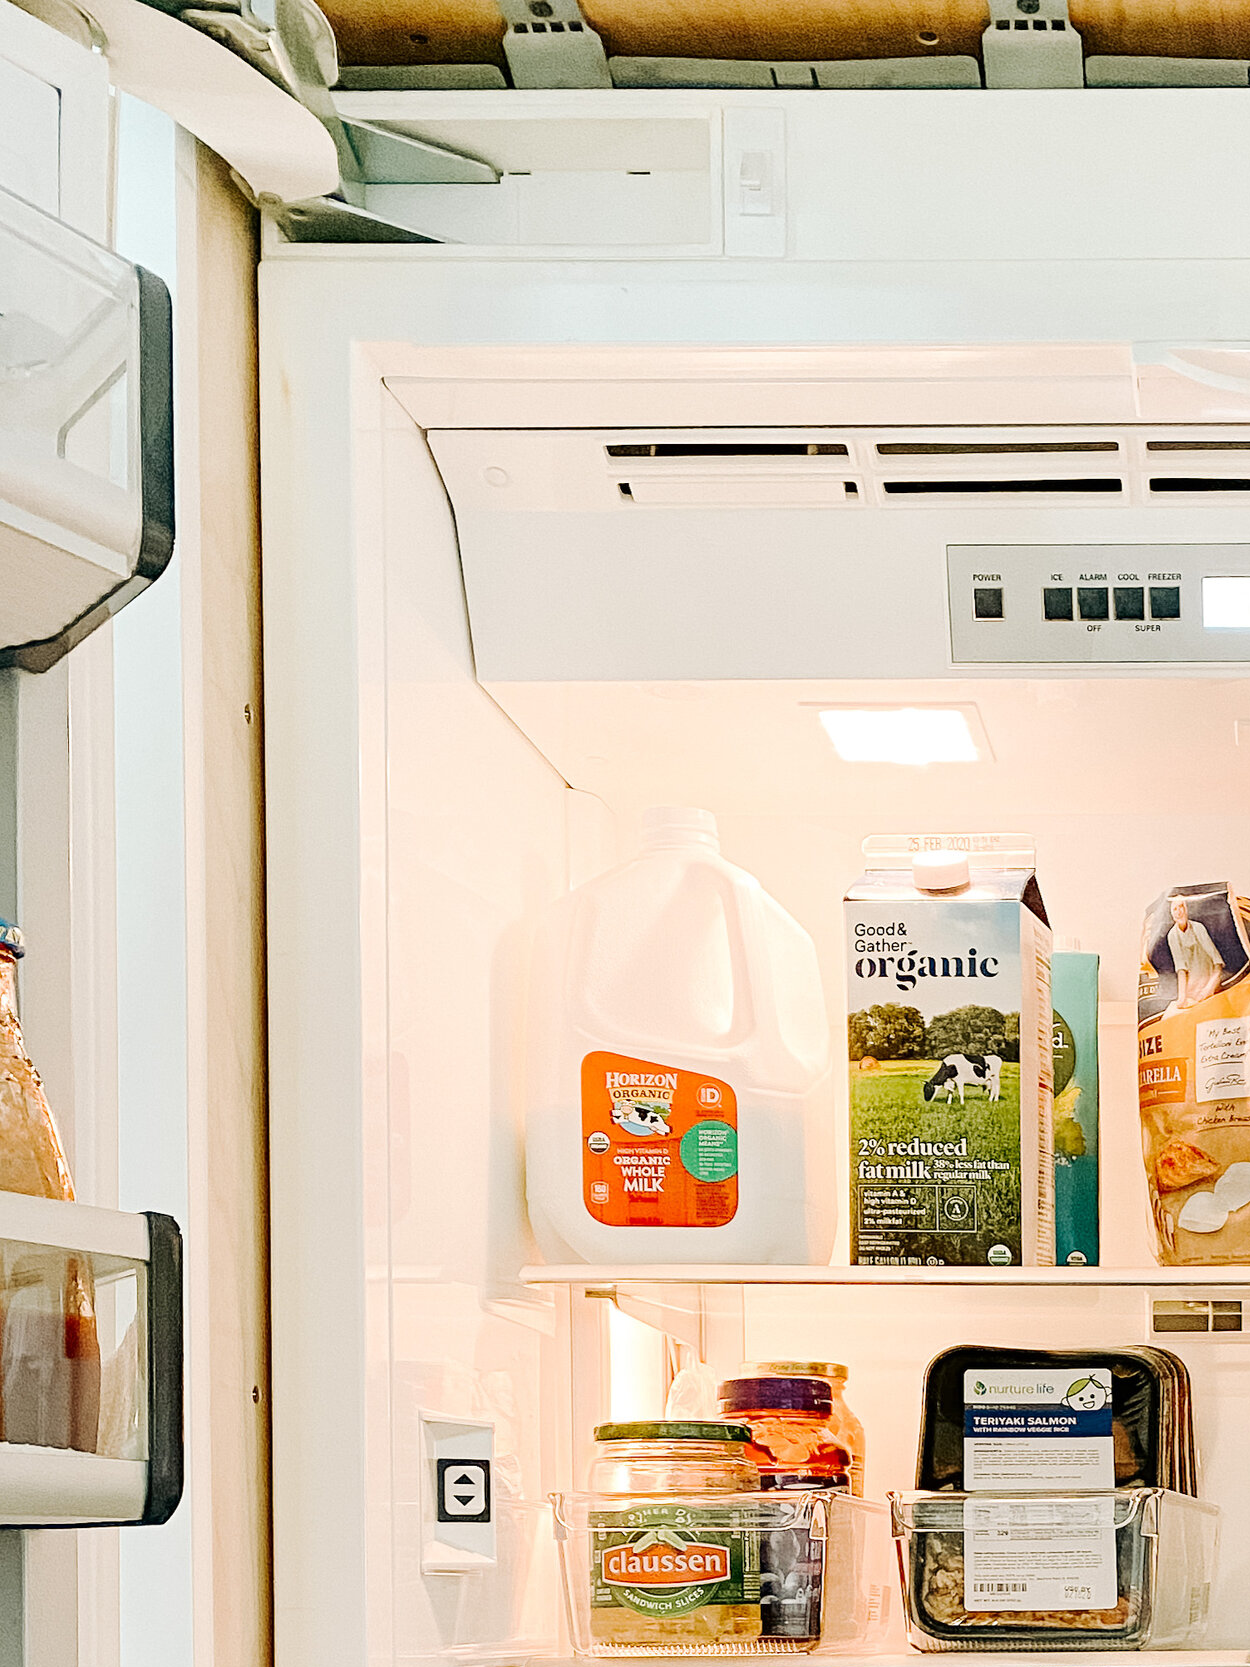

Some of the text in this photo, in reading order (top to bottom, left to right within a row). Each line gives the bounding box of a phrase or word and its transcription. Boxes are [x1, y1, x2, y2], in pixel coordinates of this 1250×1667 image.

[972, 574, 1002, 582] POWER
[1050, 573, 1182, 581] ICE ALARM COOL FREEZER
[1086, 624, 1161, 633] OFF SUPER
[924, 837, 942, 851] FEB
[854, 922, 908, 937] Good &
[854, 938, 907, 953] Gather
[855, 947, 1000, 991] organic
[606, 1072, 678, 1090] HORIZON
[612, 1089, 671, 1100] ORGANIC
[857, 1137, 968, 1157] 2% reduced
[613, 1156, 671, 1166] ORGANIC
[955, 1159, 973, 1169] less
[973, 1159, 987, 1169] fat
[987, 1159, 1010, 1170] than
[620, 1165, 666, 1177] WHOLE
[857, 1160, 932, 1179] fat milk
[933, 1169, 992, 1181] regular milk
[623, 1178, 665, 1192] MILK
[863, 1189, 891, 1197] vitamin
[891, 1189, 899, 1197] A
[863, 1197, 880, 1206] high
[880, 1197, 909, 1205] vitamin
[988, 1382, 1055, 1395] nurture life
[973, 1416, 1077, 1426] TERIYAKI SALMON
[609, 1550, 722, 1574] claussen
[622, 1586, 705, 1610] SANDWICH SLICES
